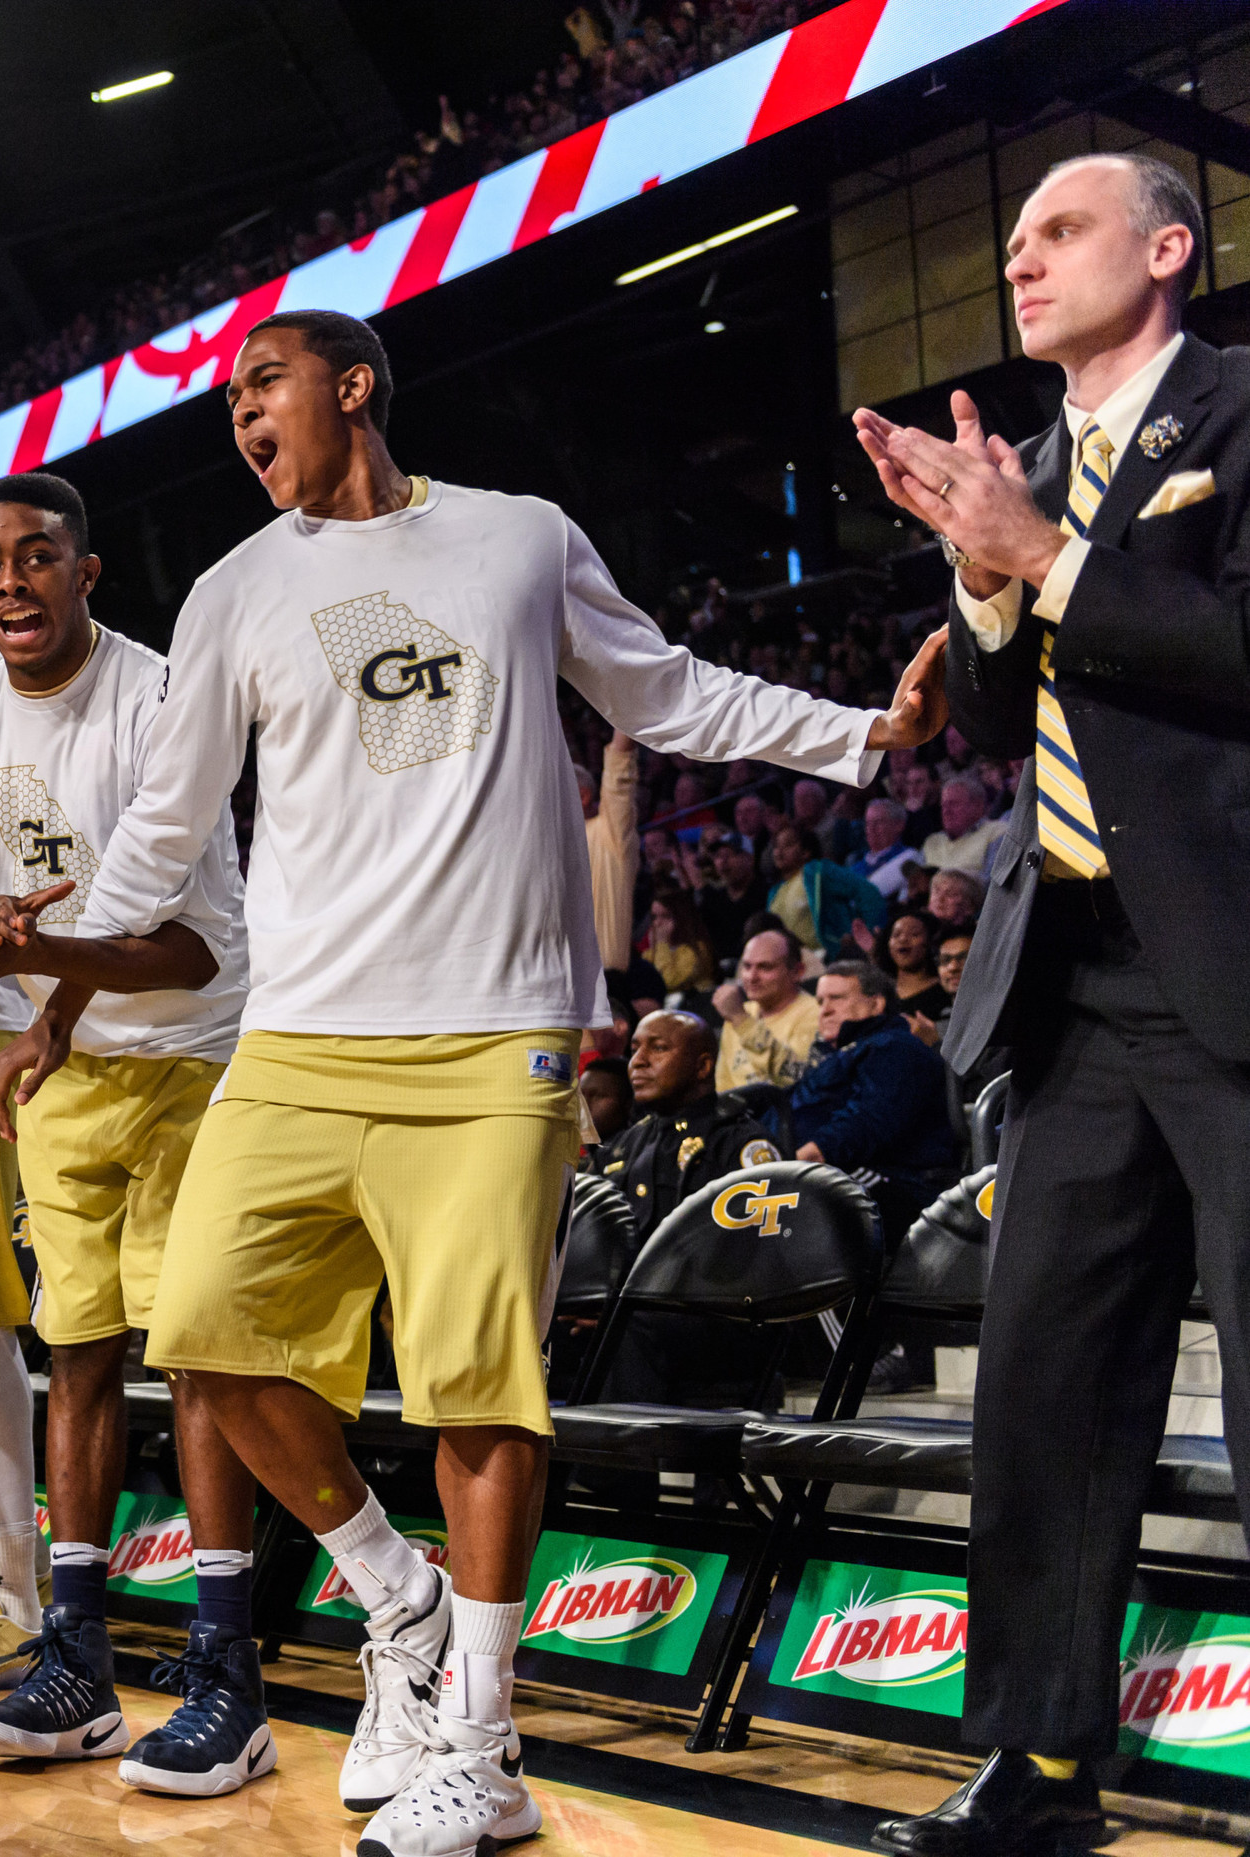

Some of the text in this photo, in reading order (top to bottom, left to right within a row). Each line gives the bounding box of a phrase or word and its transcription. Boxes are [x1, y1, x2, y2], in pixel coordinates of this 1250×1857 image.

[360, 642, 463, 703] GT
[711, 1178, 800, 1238] GT
[107, 1528, 193, 1579] LIBMA
[521, 1574, 688, 1640] LIBMAN
